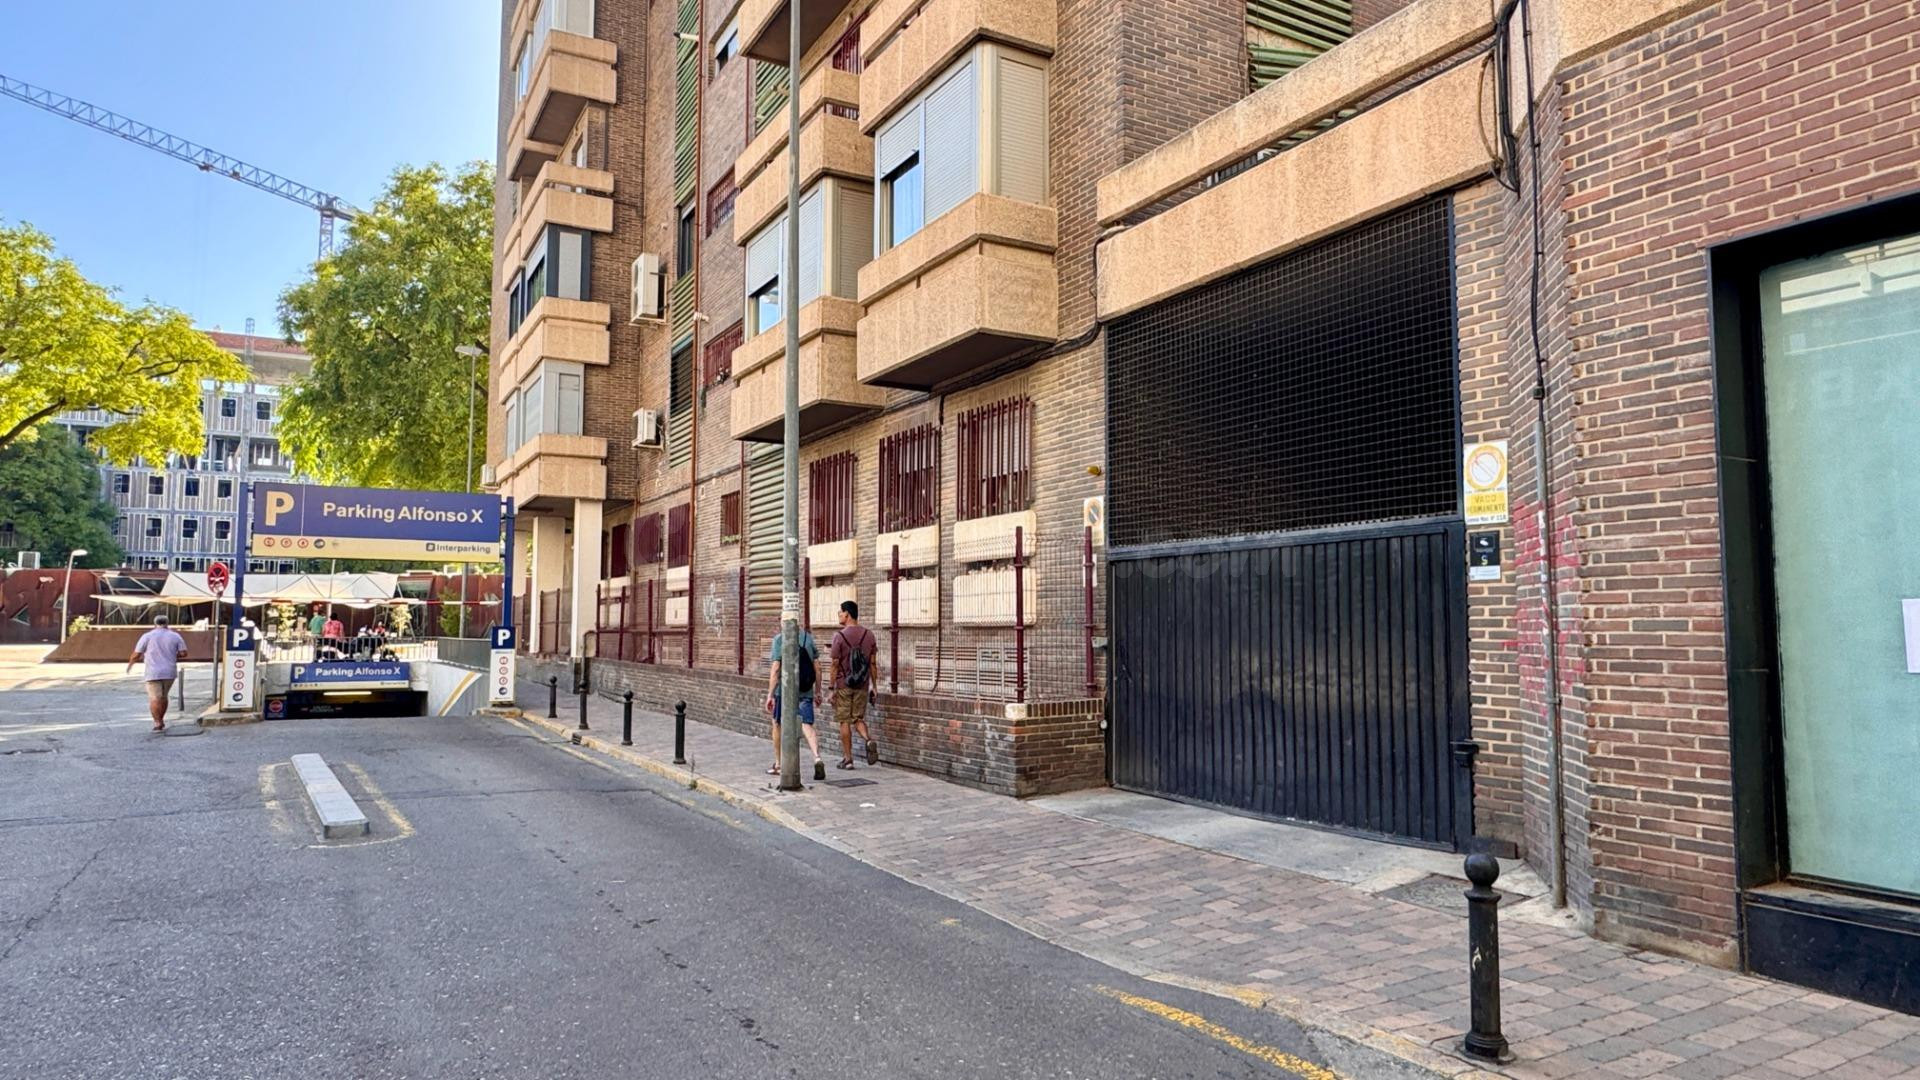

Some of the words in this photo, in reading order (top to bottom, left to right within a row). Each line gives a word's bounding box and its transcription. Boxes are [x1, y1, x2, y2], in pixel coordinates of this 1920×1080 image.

[265, 490, 294, 526] P
[323, 502, 395, 523] Parking
[398, 506, 468, 522] Alfonso
[471, 509, 484, 524] X
[233, 629, 249, 648] P
[497, 629, 511, 646] P
[294, 666, 305, 679] P
[315, 667, 353, 677] Parking
[354, 667, 393, 676] Alfonso
[393, 666, 401, 675] X
